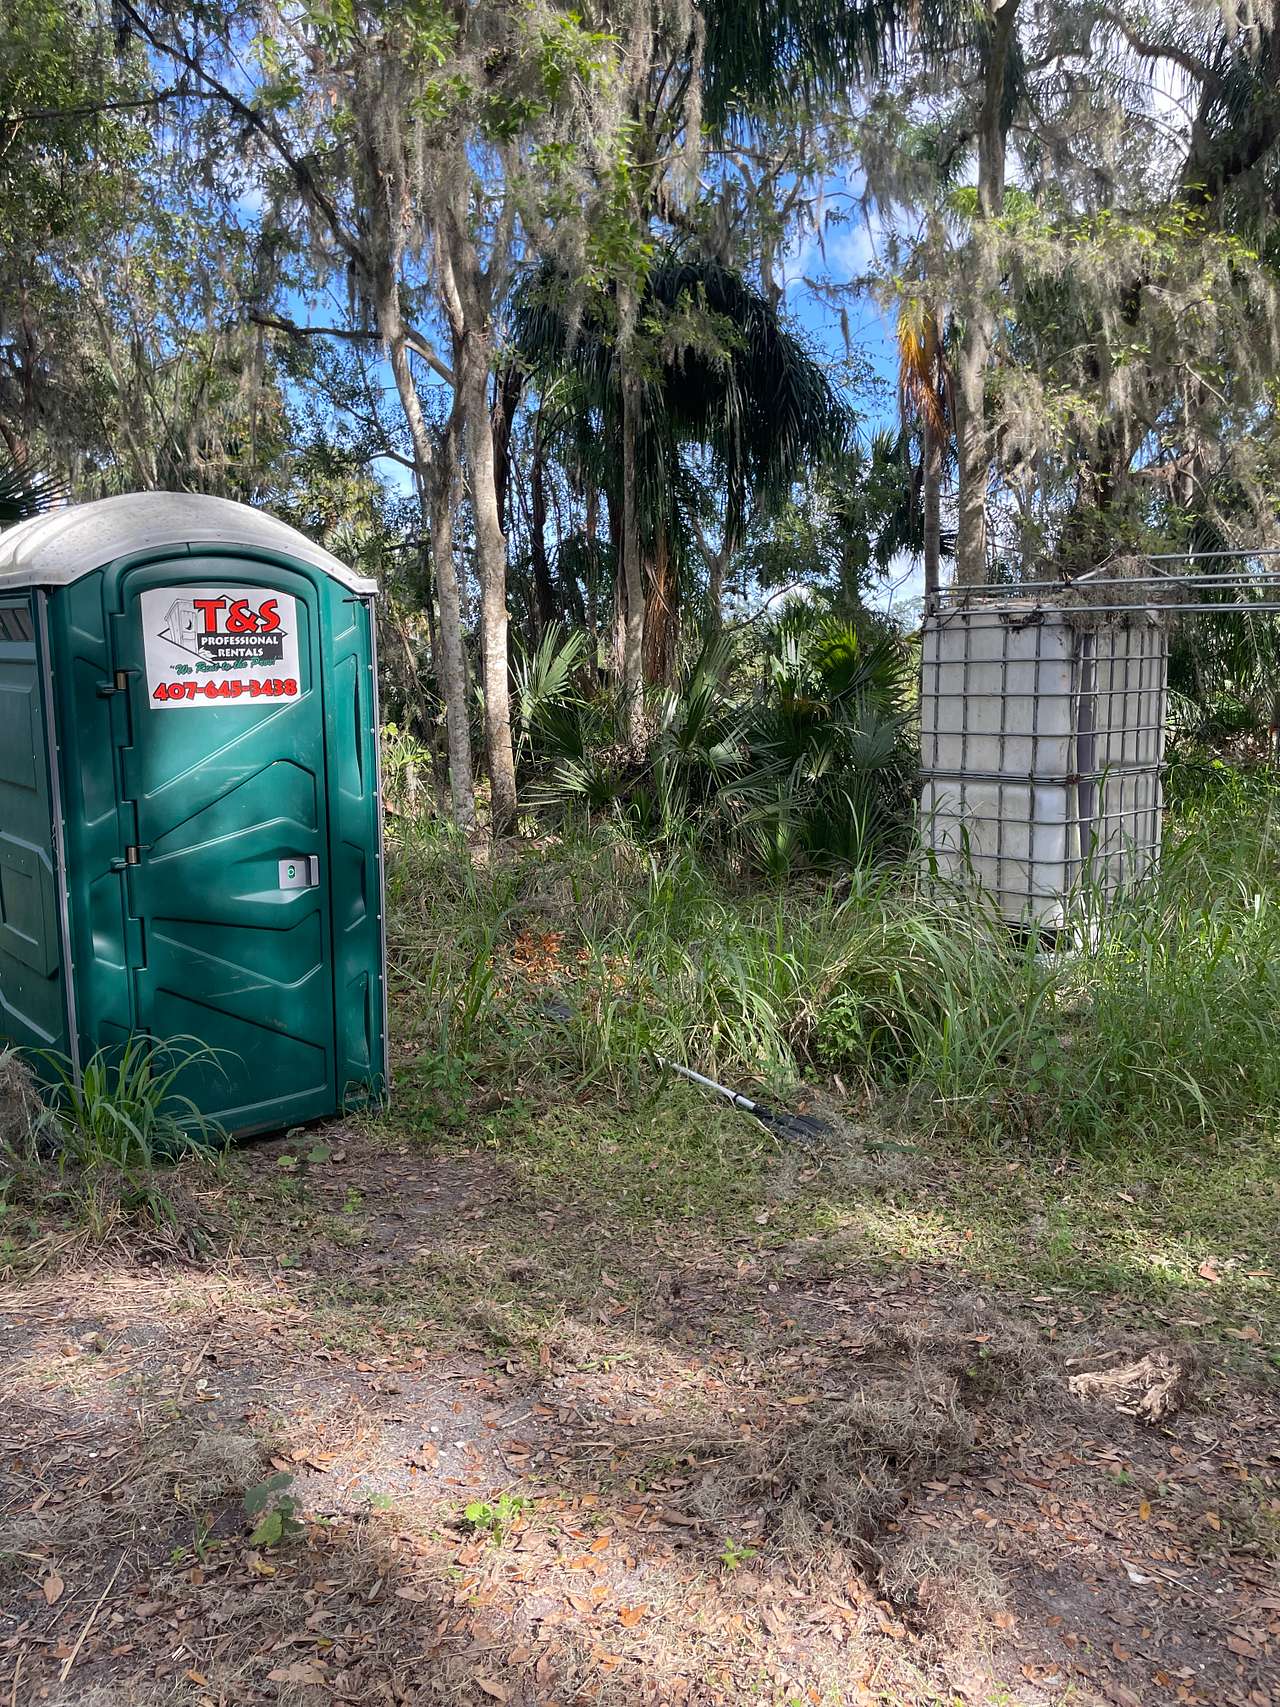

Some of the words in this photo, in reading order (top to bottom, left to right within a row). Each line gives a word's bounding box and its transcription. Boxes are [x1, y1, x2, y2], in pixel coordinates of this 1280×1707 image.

[193, 599, 281, 633] T&S
[201, 635, 279, 646] PROFESSIONAL
[217, 648, 264, 658] RENTALS
[233, 658, 248, 669] the
[153, 679, 298, 701] 407-645-3438
